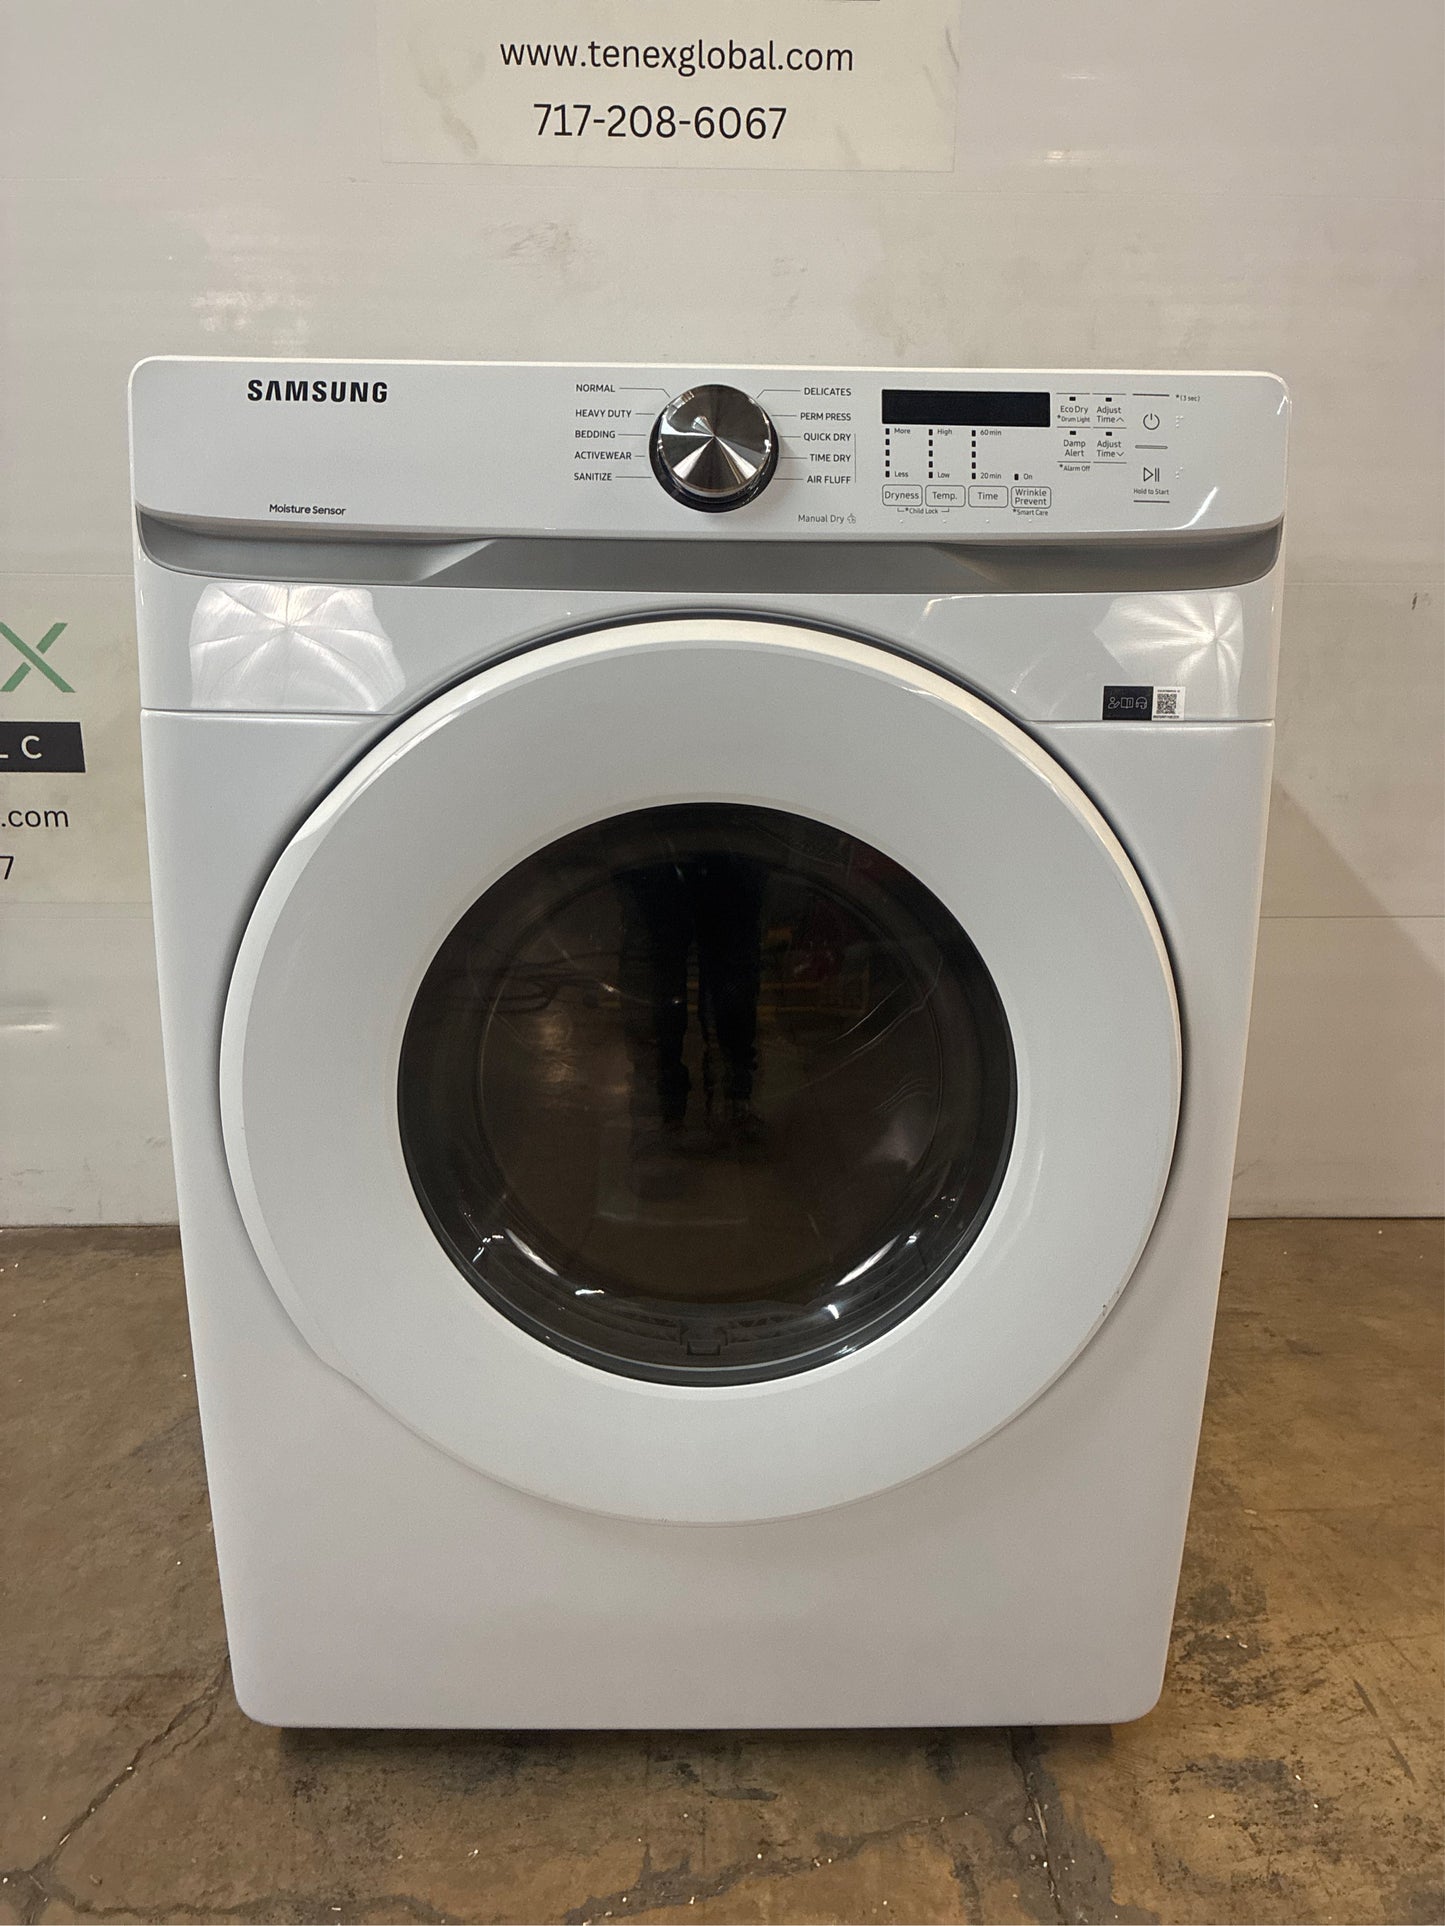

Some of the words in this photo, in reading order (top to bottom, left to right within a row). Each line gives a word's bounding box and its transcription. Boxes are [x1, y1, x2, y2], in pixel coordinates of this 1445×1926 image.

[500, 40, 854, 76] www.tenexglobal.com
[533, 103, 787, 140] 717-208-6067
[247, 380, 388, 403] SAMSUNG
[576, 384, 615, 393] NORMAL
[804, 387, 851, 396] DELICATES
[576, 409, 606, 417] HEAVY
[607, 409, 632, 417] DUTY
[1075, 405, 1089, 415] Dry
[1097, 405, 1121, 415] Adjust
[800, 412, 822, 420] PERM
[824, 412, 851, 421] PRESS
[1097, 415, 1115, 423] Time
[575, 430, 615, 438] BEDDING
[804, 432, 831, 441] QUICK
[833, 433, 851, 441] DRY
[937, 428, 952, 436] High
[1063, 440, 1086, 449] Damp
[1097, 440, 1121, 449] Adjust
[575, 451, 632, 460] ACTIVEWEAR
[1064, 449, 1084, 457] Alert
[1097, 450, 1115, 458] Time
[810, 454, 831, 462] TIME
[833, 454, 851, 462] DRY
[574, 472, 612, 481] SANITIZE
[807, 475, 821, 484] AIR
[824, 475, 851, 484] FLUFF
[884, 490, 920, 501] Dryness
[932, 491, 957, 501] Temp.
[978, 491, 998, 500] Time
[1015, 488, 1047, 497] Wrinkle
[1015, 497, 1047, 505] Prevent
[269, 504, 311, 514] Moisture
[313, 506, 346, 516] Sensor
[925, 507, 939, 515] Lock
[798, 514, 827, 523] Manual
[829, 515, 844, 524] Dry
